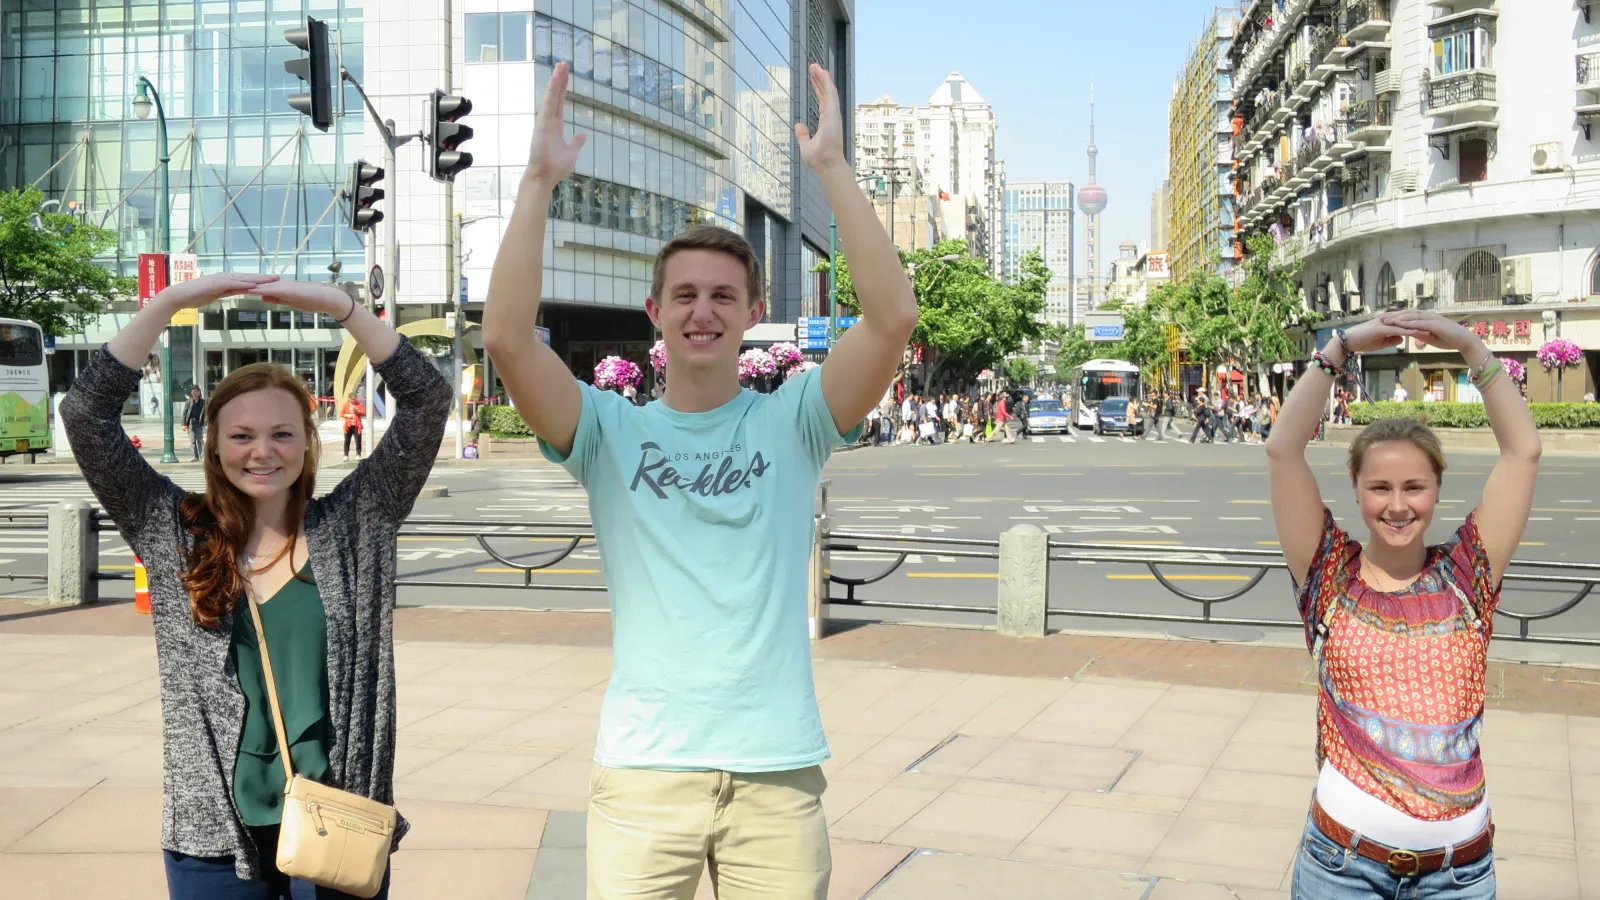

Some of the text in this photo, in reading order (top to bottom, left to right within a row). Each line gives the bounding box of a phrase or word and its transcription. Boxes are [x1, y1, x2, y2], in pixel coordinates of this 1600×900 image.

[1460, 320, 1531, 337] 楼集团
[668, 443, 742, 462] LOS ANGES
